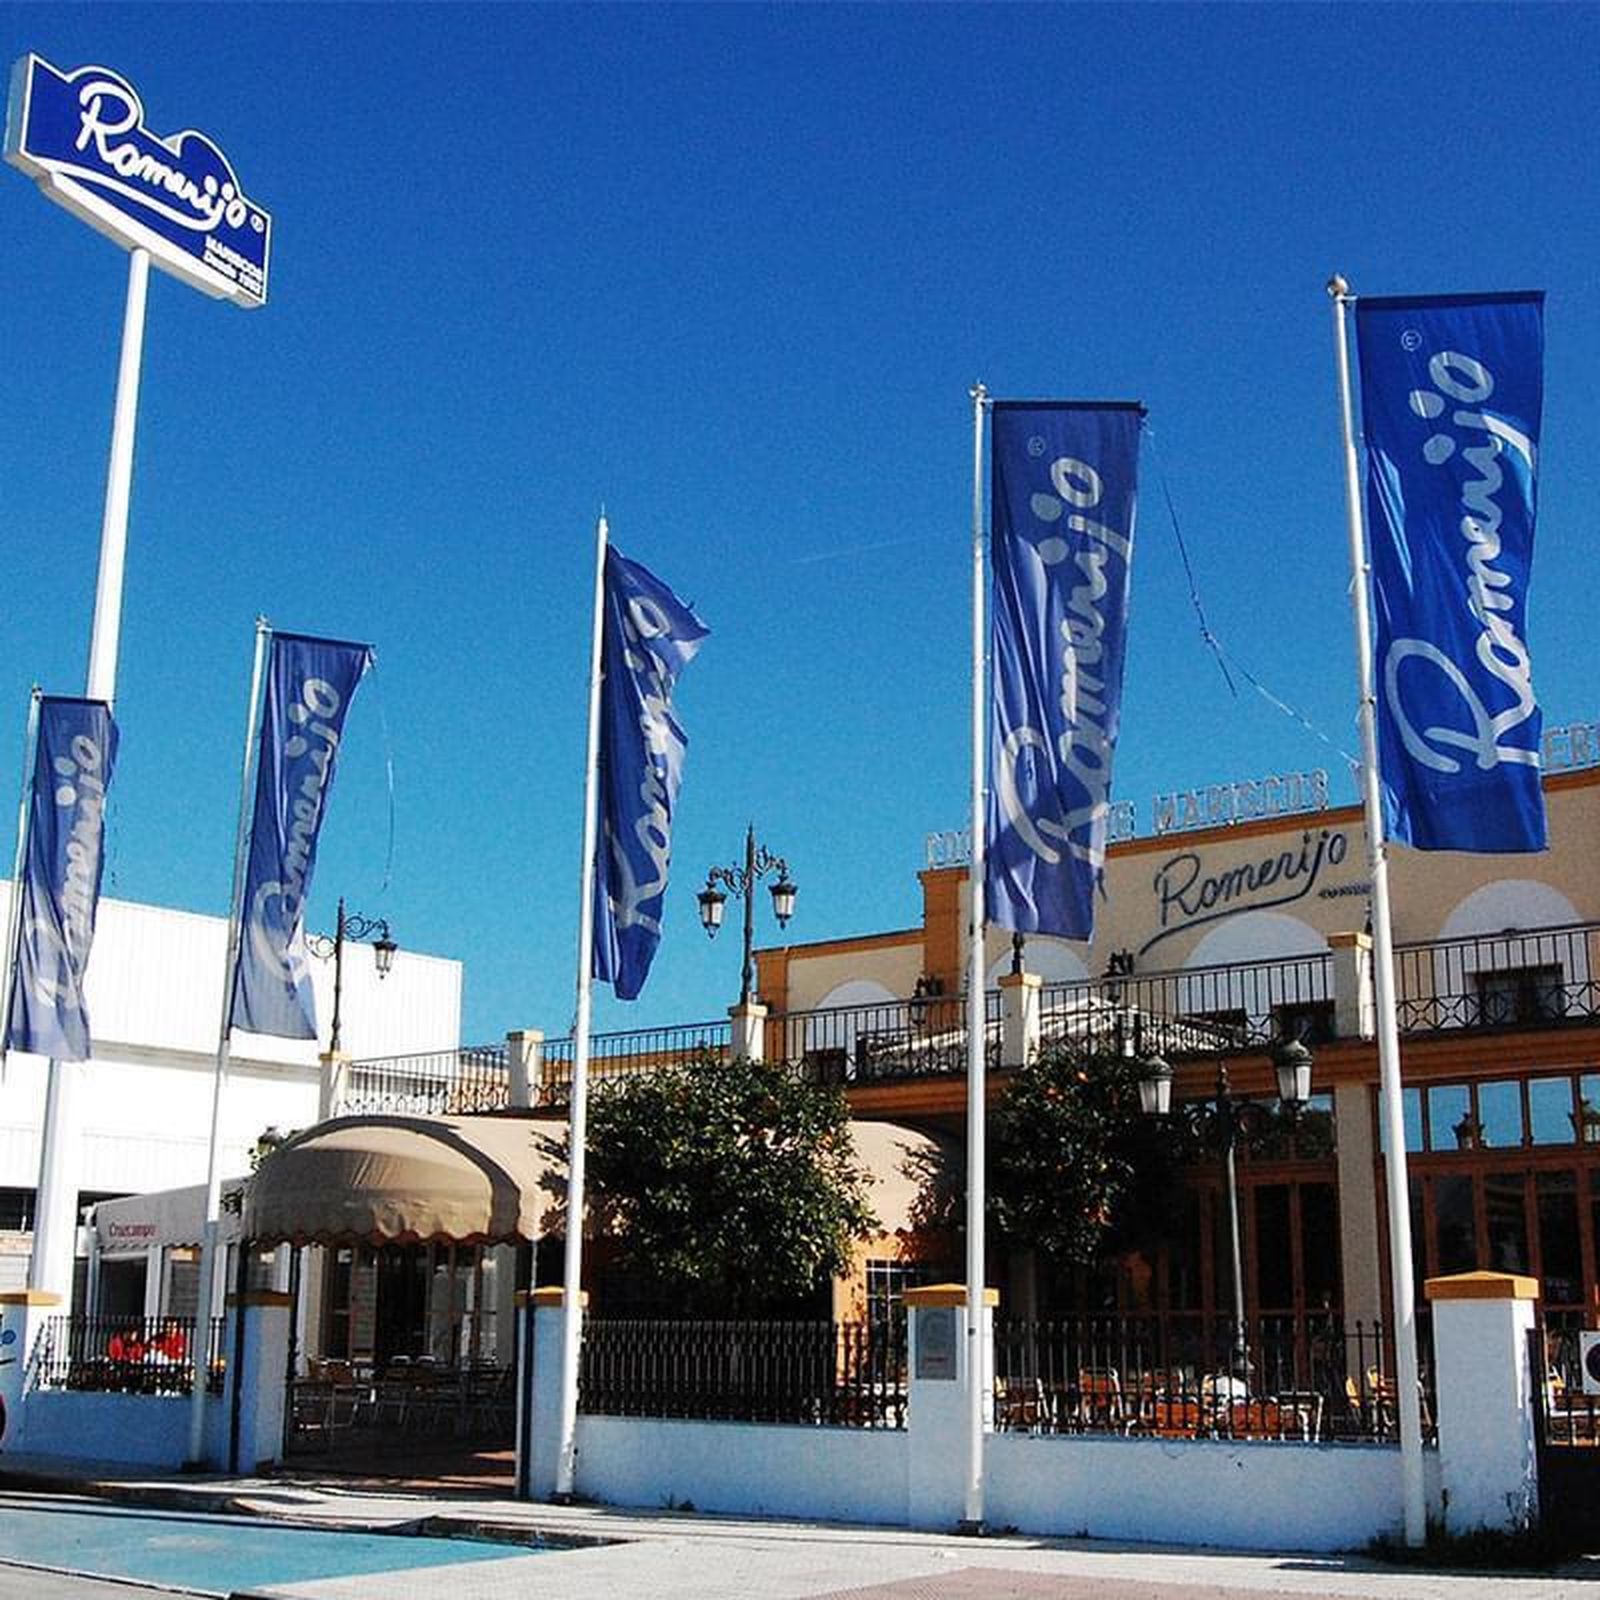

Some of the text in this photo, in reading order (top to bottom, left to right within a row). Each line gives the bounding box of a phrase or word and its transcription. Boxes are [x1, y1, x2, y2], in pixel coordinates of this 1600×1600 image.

[998, 457, 1133, 867] Romerijo
[1384, 351, 1541, 774] Romerijo
[1153, 831, 1347, 927] Romerijo
